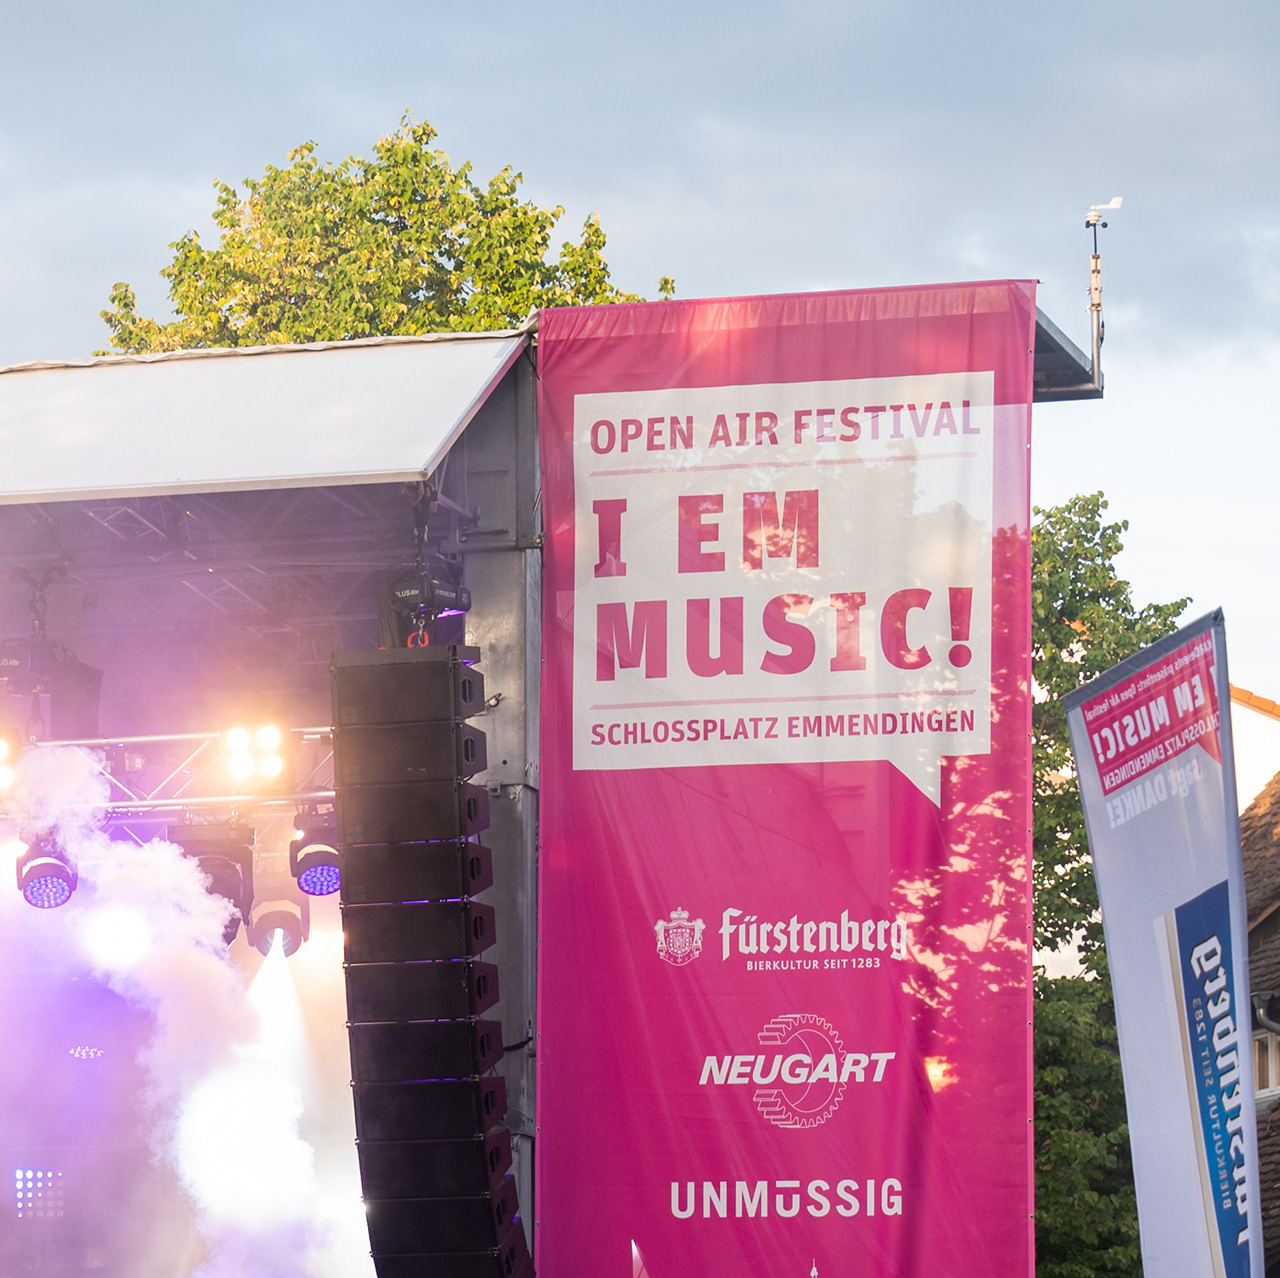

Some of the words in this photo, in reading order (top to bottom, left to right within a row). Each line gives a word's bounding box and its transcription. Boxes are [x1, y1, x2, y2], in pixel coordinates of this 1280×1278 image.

[591, 415, 694, 455] OPEN
[708, 411, 780, 448] AIR
[794, 400, 981, 444] FESTIVAL
[592, 498, 628, 578] I
[677, 488, 820, 574] EM
[595, 586, 973, 682] MUSIC!
[591, 717, 778, 746] SCHLOSSPLATZ
[788, 709, 974, 738] EMMENDINGEN
[718, 906, 908, 962] Fürstenberg
[746, 959, 820, 971] BIERKULTUR
[823, 958, 848, 970] SEIT
[851, 957, 881, 969] 1283
[698, 1052, 896, 1085] NEUGART
